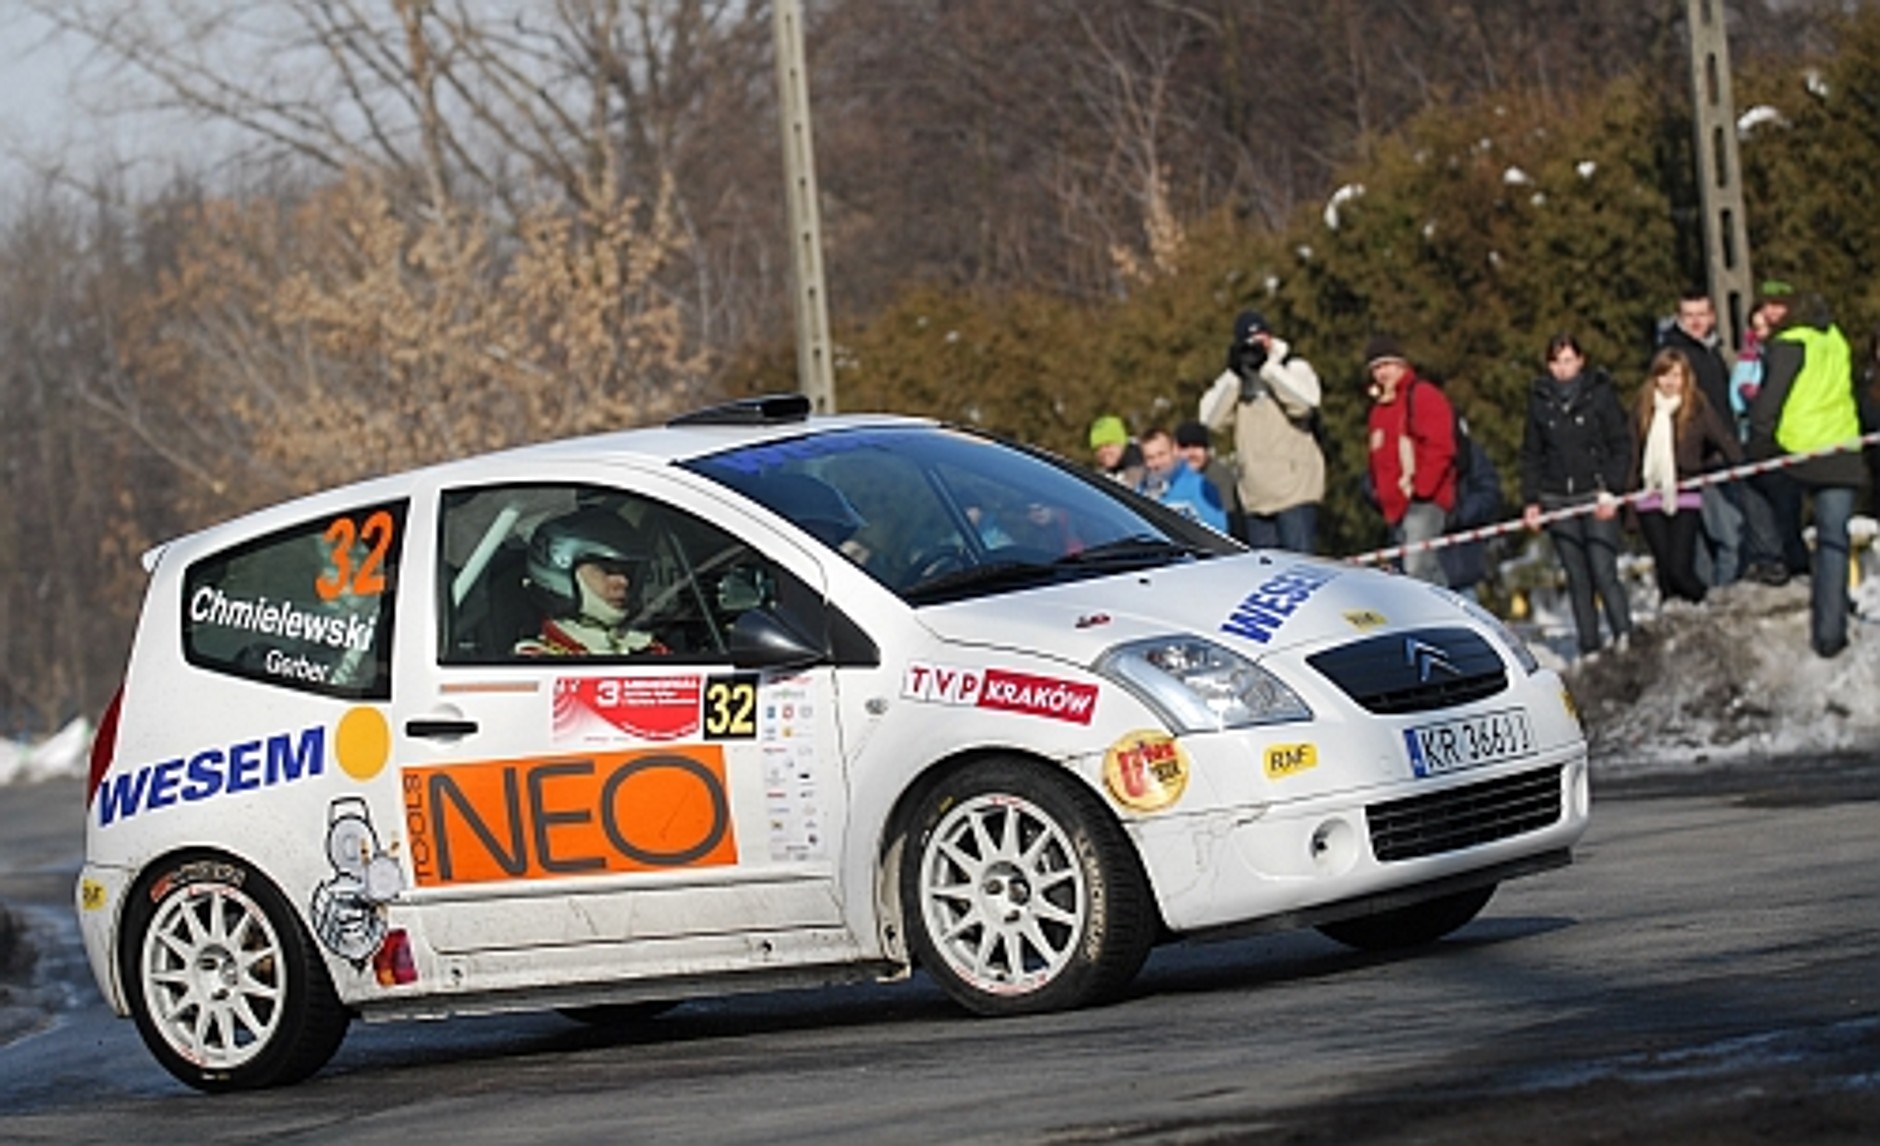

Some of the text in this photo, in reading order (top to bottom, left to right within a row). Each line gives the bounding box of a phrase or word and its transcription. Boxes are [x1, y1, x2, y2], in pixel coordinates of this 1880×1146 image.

[315, 510, 394, 602] 32
[190, 585, 377, 651] Chmielewski
[706, 683, 755, 735] 32
[911, 666, 1092, 714] TVP KRAKÓW
[98, 725, 325, 828] WESEM
[1421, 728, 1461, 768] KR
[403, 754, 728, 884] TOOLS NEO
